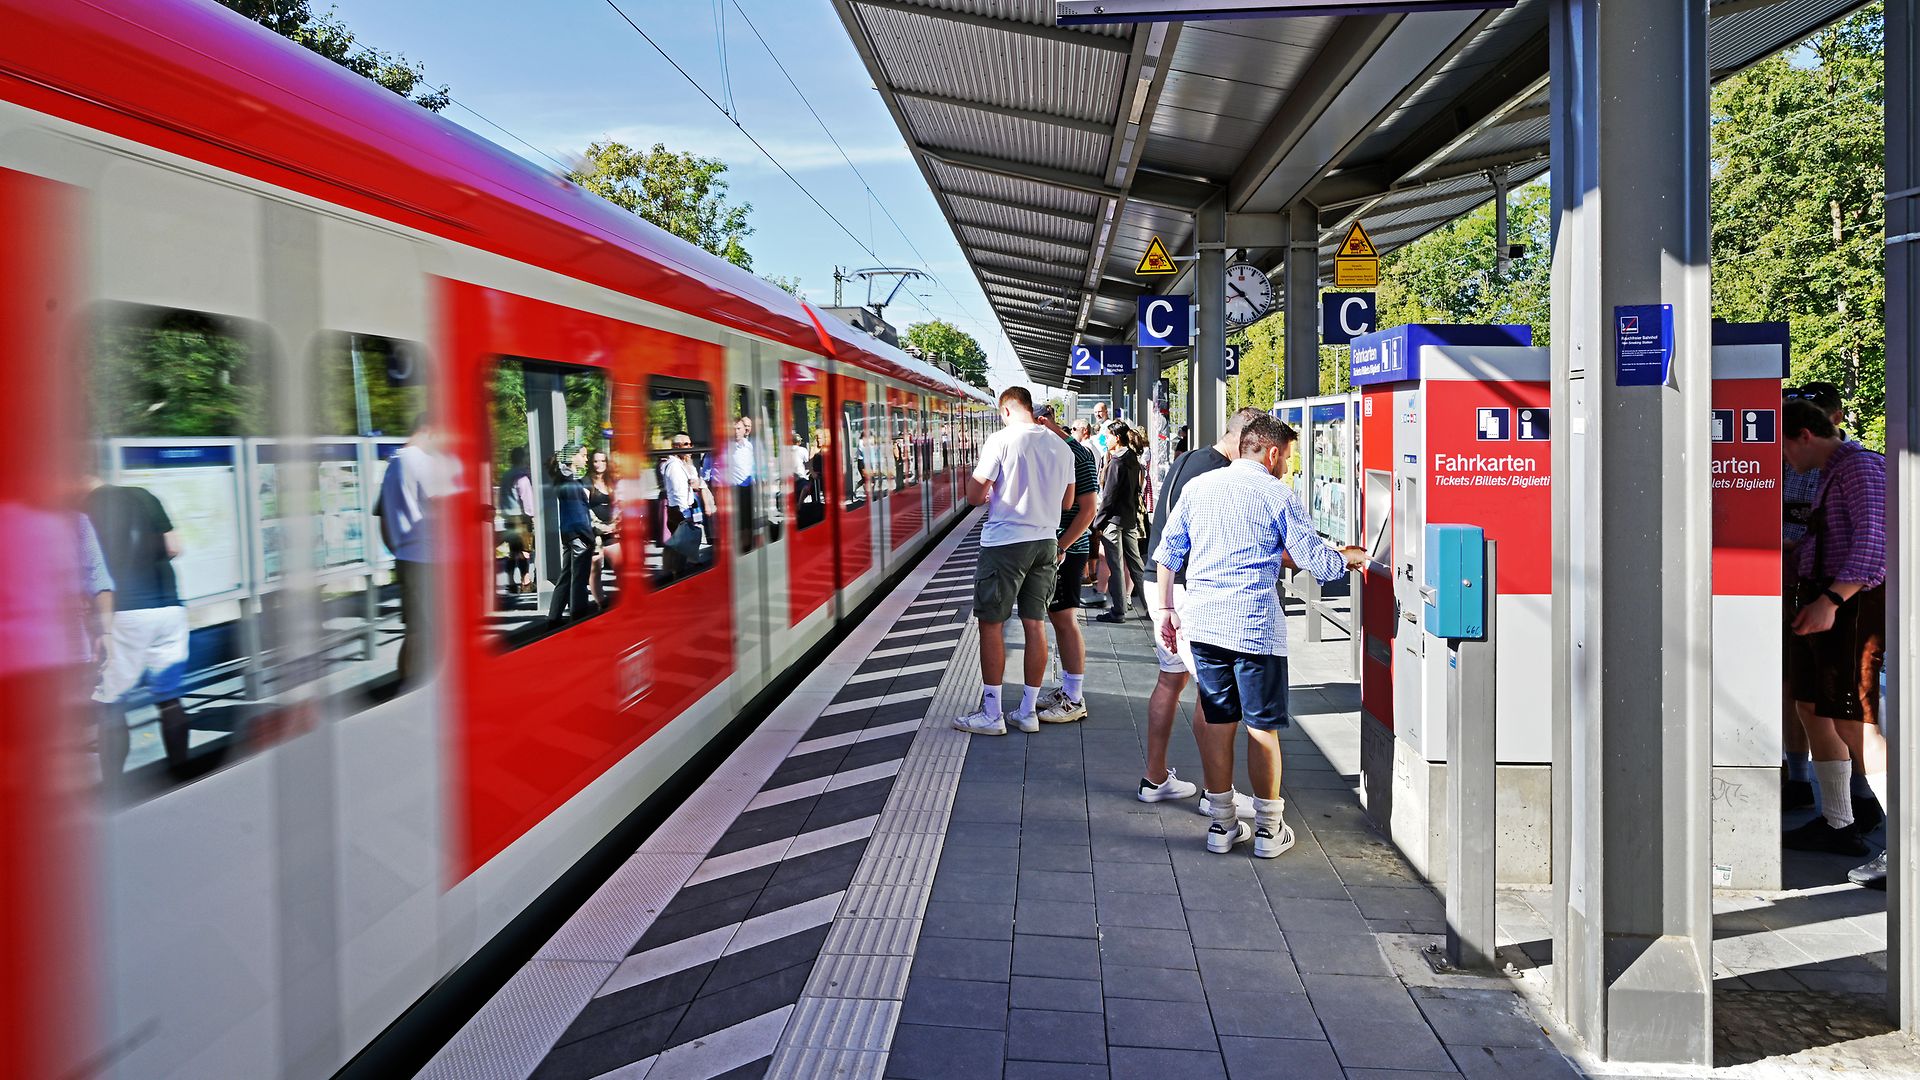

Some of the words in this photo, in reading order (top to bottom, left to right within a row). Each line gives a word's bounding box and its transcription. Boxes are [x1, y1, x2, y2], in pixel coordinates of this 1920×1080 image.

[1145, 299, 1174, 339] C
[1340, 296, 1369, 336] C
[1075, 347, 1090, 370] 2
[1434, 453, 1536, 472] Fahrkarten
[1711, 457, 1760, 474] arten
[1712, 478, 1776, 491] lets/Biglietti
